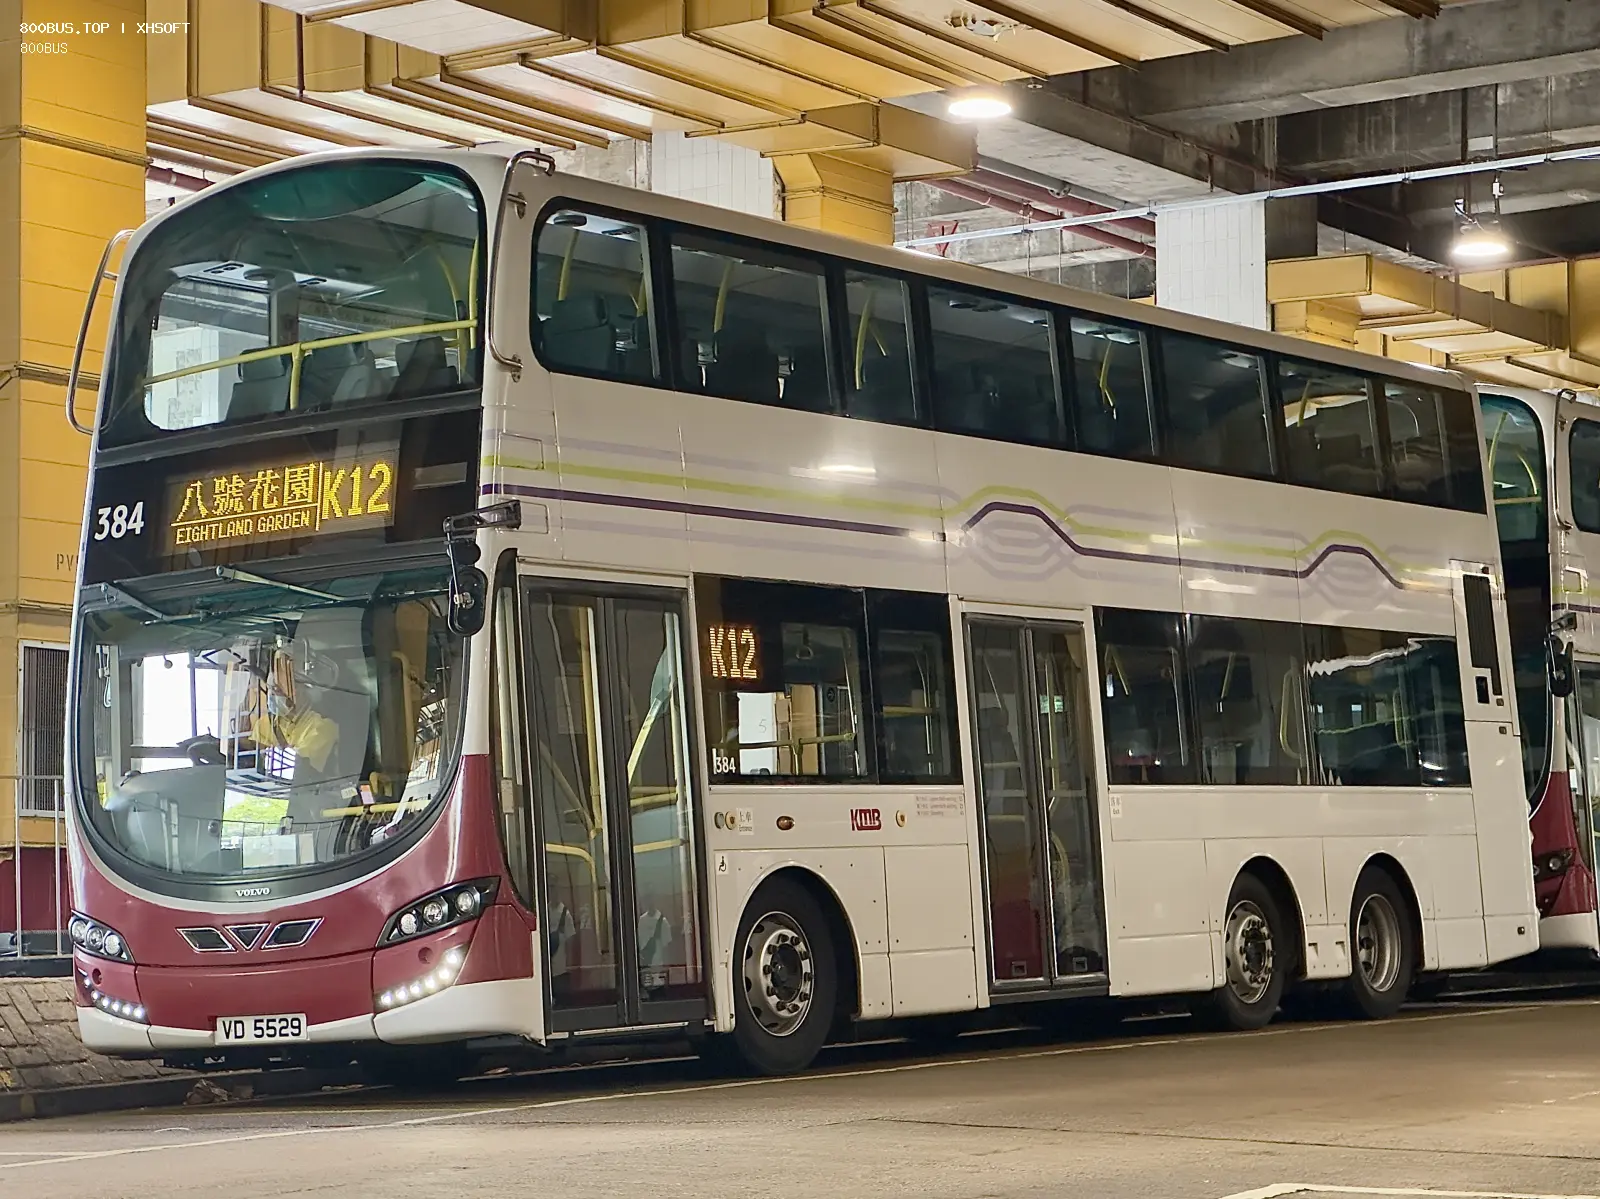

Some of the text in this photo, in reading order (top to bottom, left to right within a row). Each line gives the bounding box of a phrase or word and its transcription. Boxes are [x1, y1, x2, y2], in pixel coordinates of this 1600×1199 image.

[176, 462, 317, 522] 八號花園
[321, 460, 393, 520] K12
[94, 501, 144, 540] 384
[176, 510, 310, 545] EIGHTLAND GARDEN
[56, 553, 79, 571] PV
[709, 627, 757, 679] K12
[715, 756, 736, 774] 384
[850, 808, 882, 831] KMB
[236, 887, 271, 897] VOLVO
[222, 1017, 302, 1040] VD 5529
